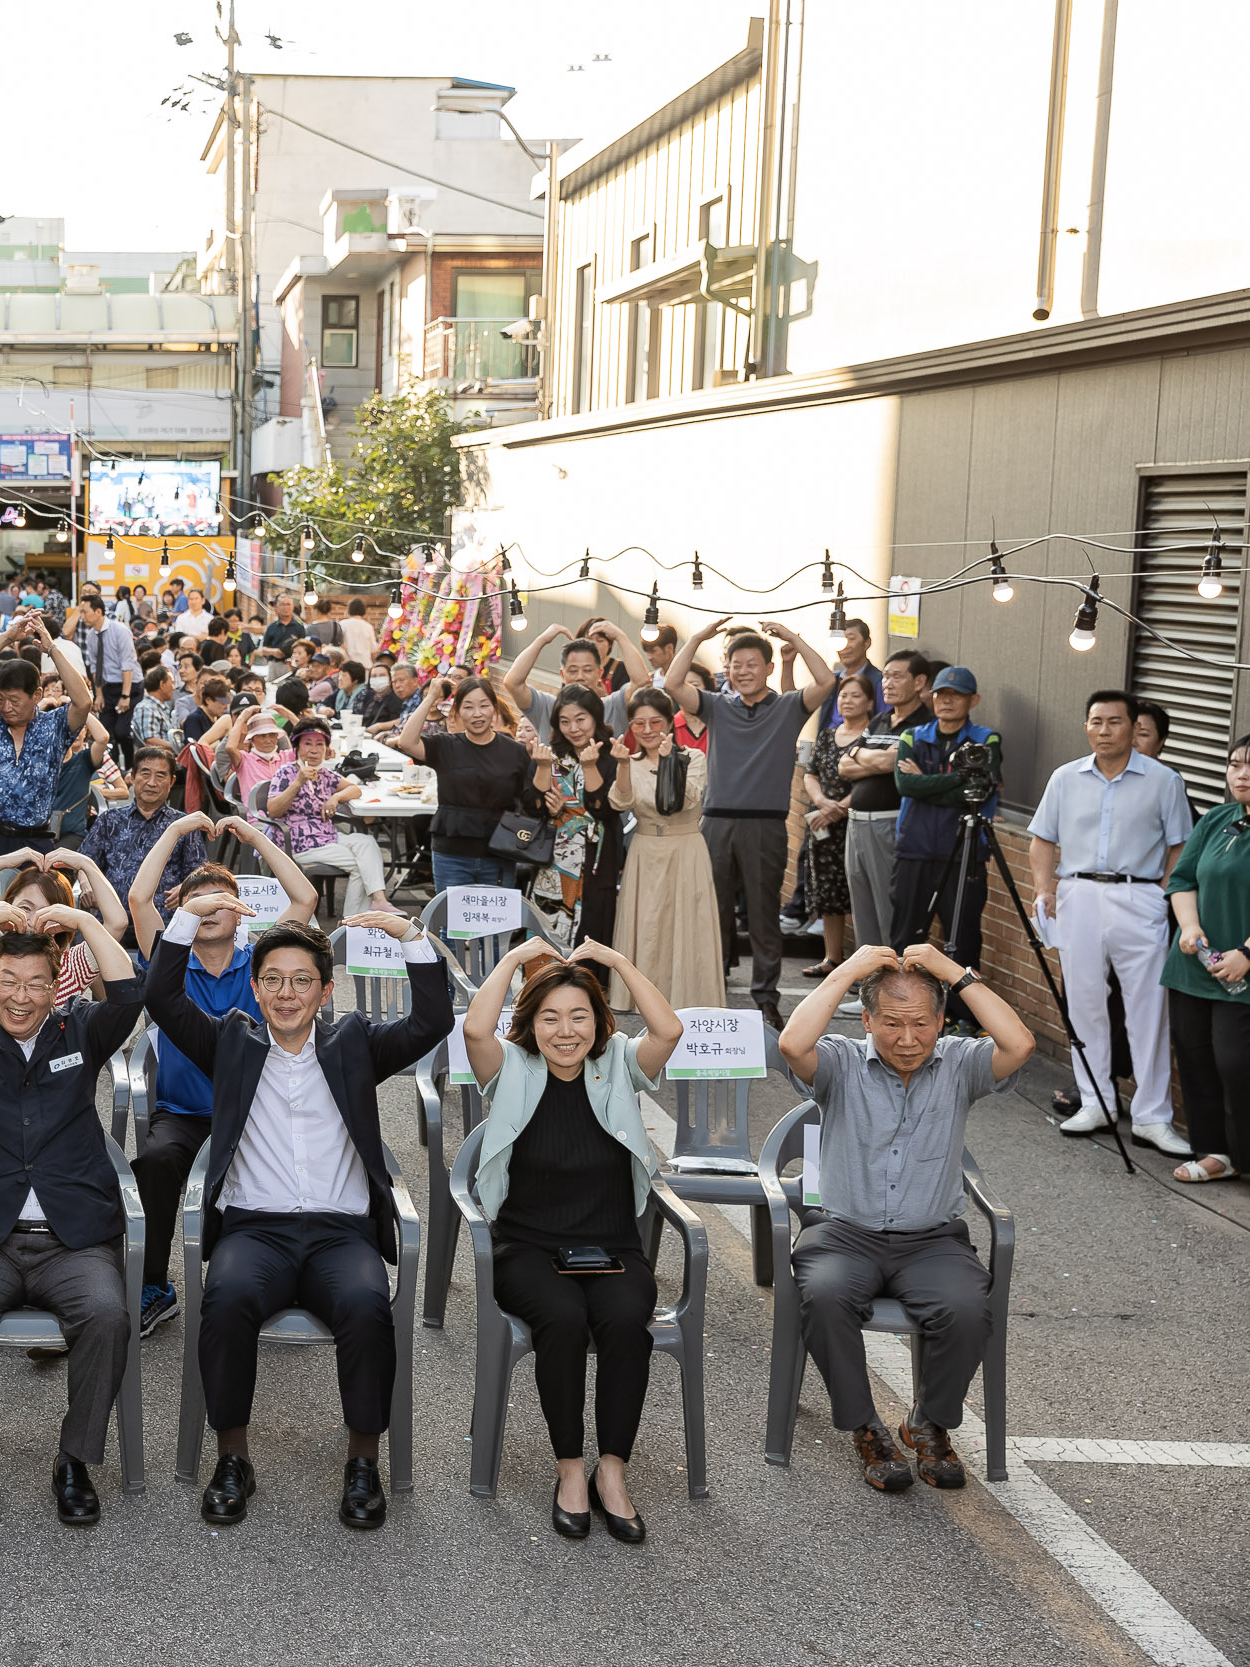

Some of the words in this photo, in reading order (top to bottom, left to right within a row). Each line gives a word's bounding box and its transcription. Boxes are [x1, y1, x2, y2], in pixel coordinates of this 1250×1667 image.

[461, 894, 508, 907] 새마을시장
[462, 911, 490, 923] 임재복
[363, 945, 392, 959] 최규철
[689, 1018, 740, 1033] 자양시장
[686, 1042, 724, 1056] 박호규
[724, 1046, 746, 1056] 회장님
